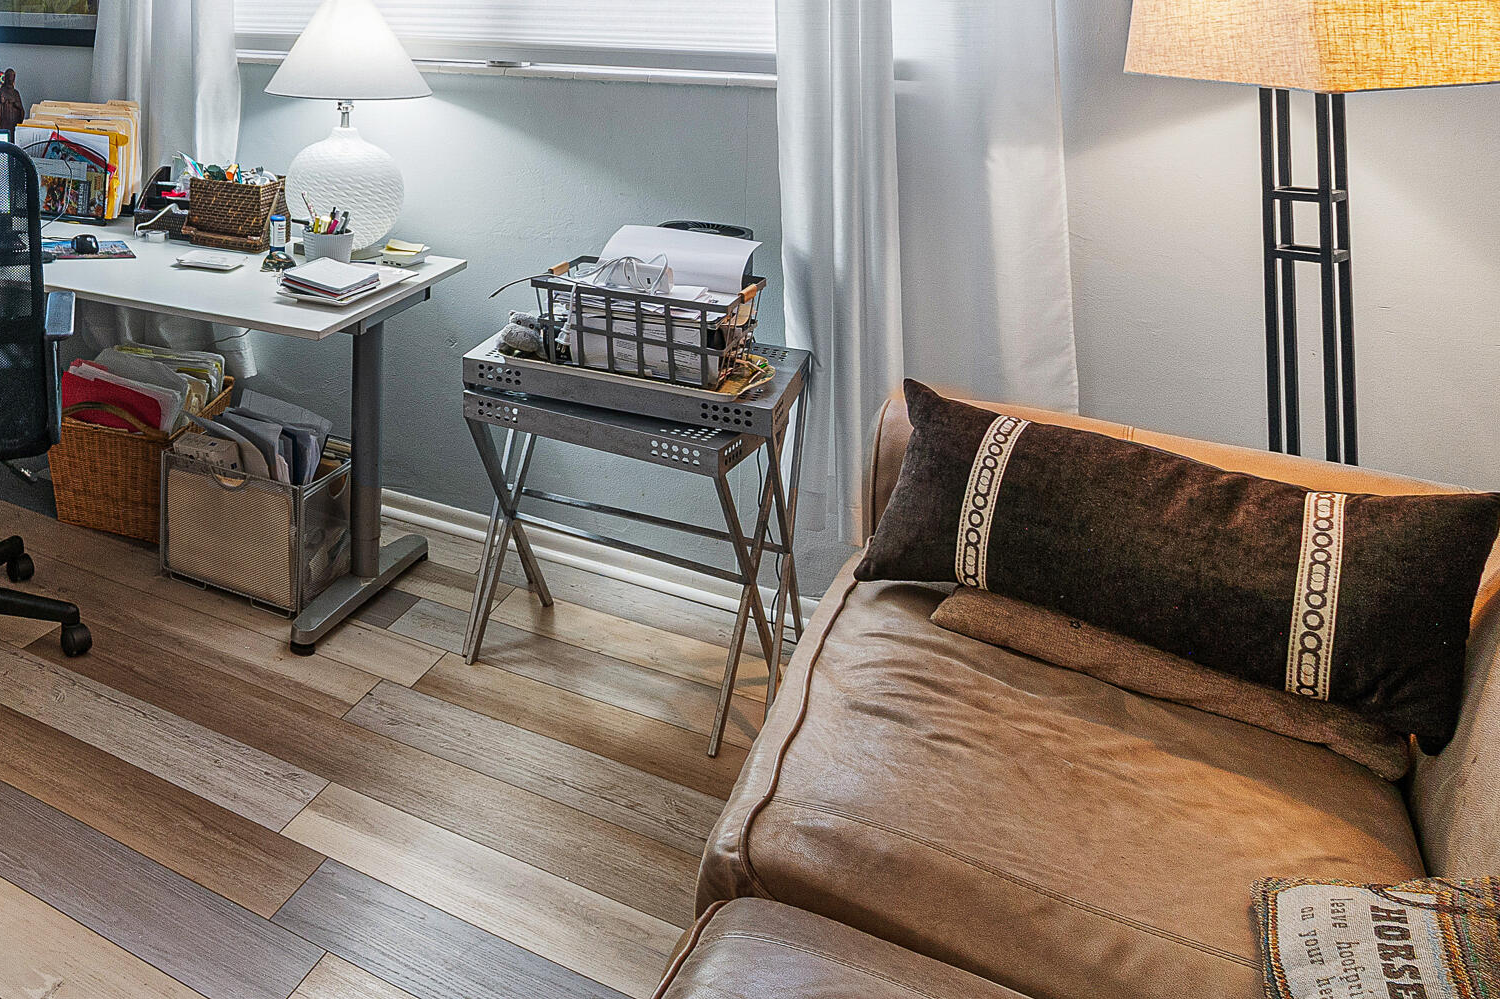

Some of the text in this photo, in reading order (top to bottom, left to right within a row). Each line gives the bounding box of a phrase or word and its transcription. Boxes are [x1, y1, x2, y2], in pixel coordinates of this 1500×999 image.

[1300, 905, 1316, 922] on
[1329, 897, 1354, 929] leave
[1298, 928, 1326, 966] your
[1370, 905, 1429, 999] HORSE
